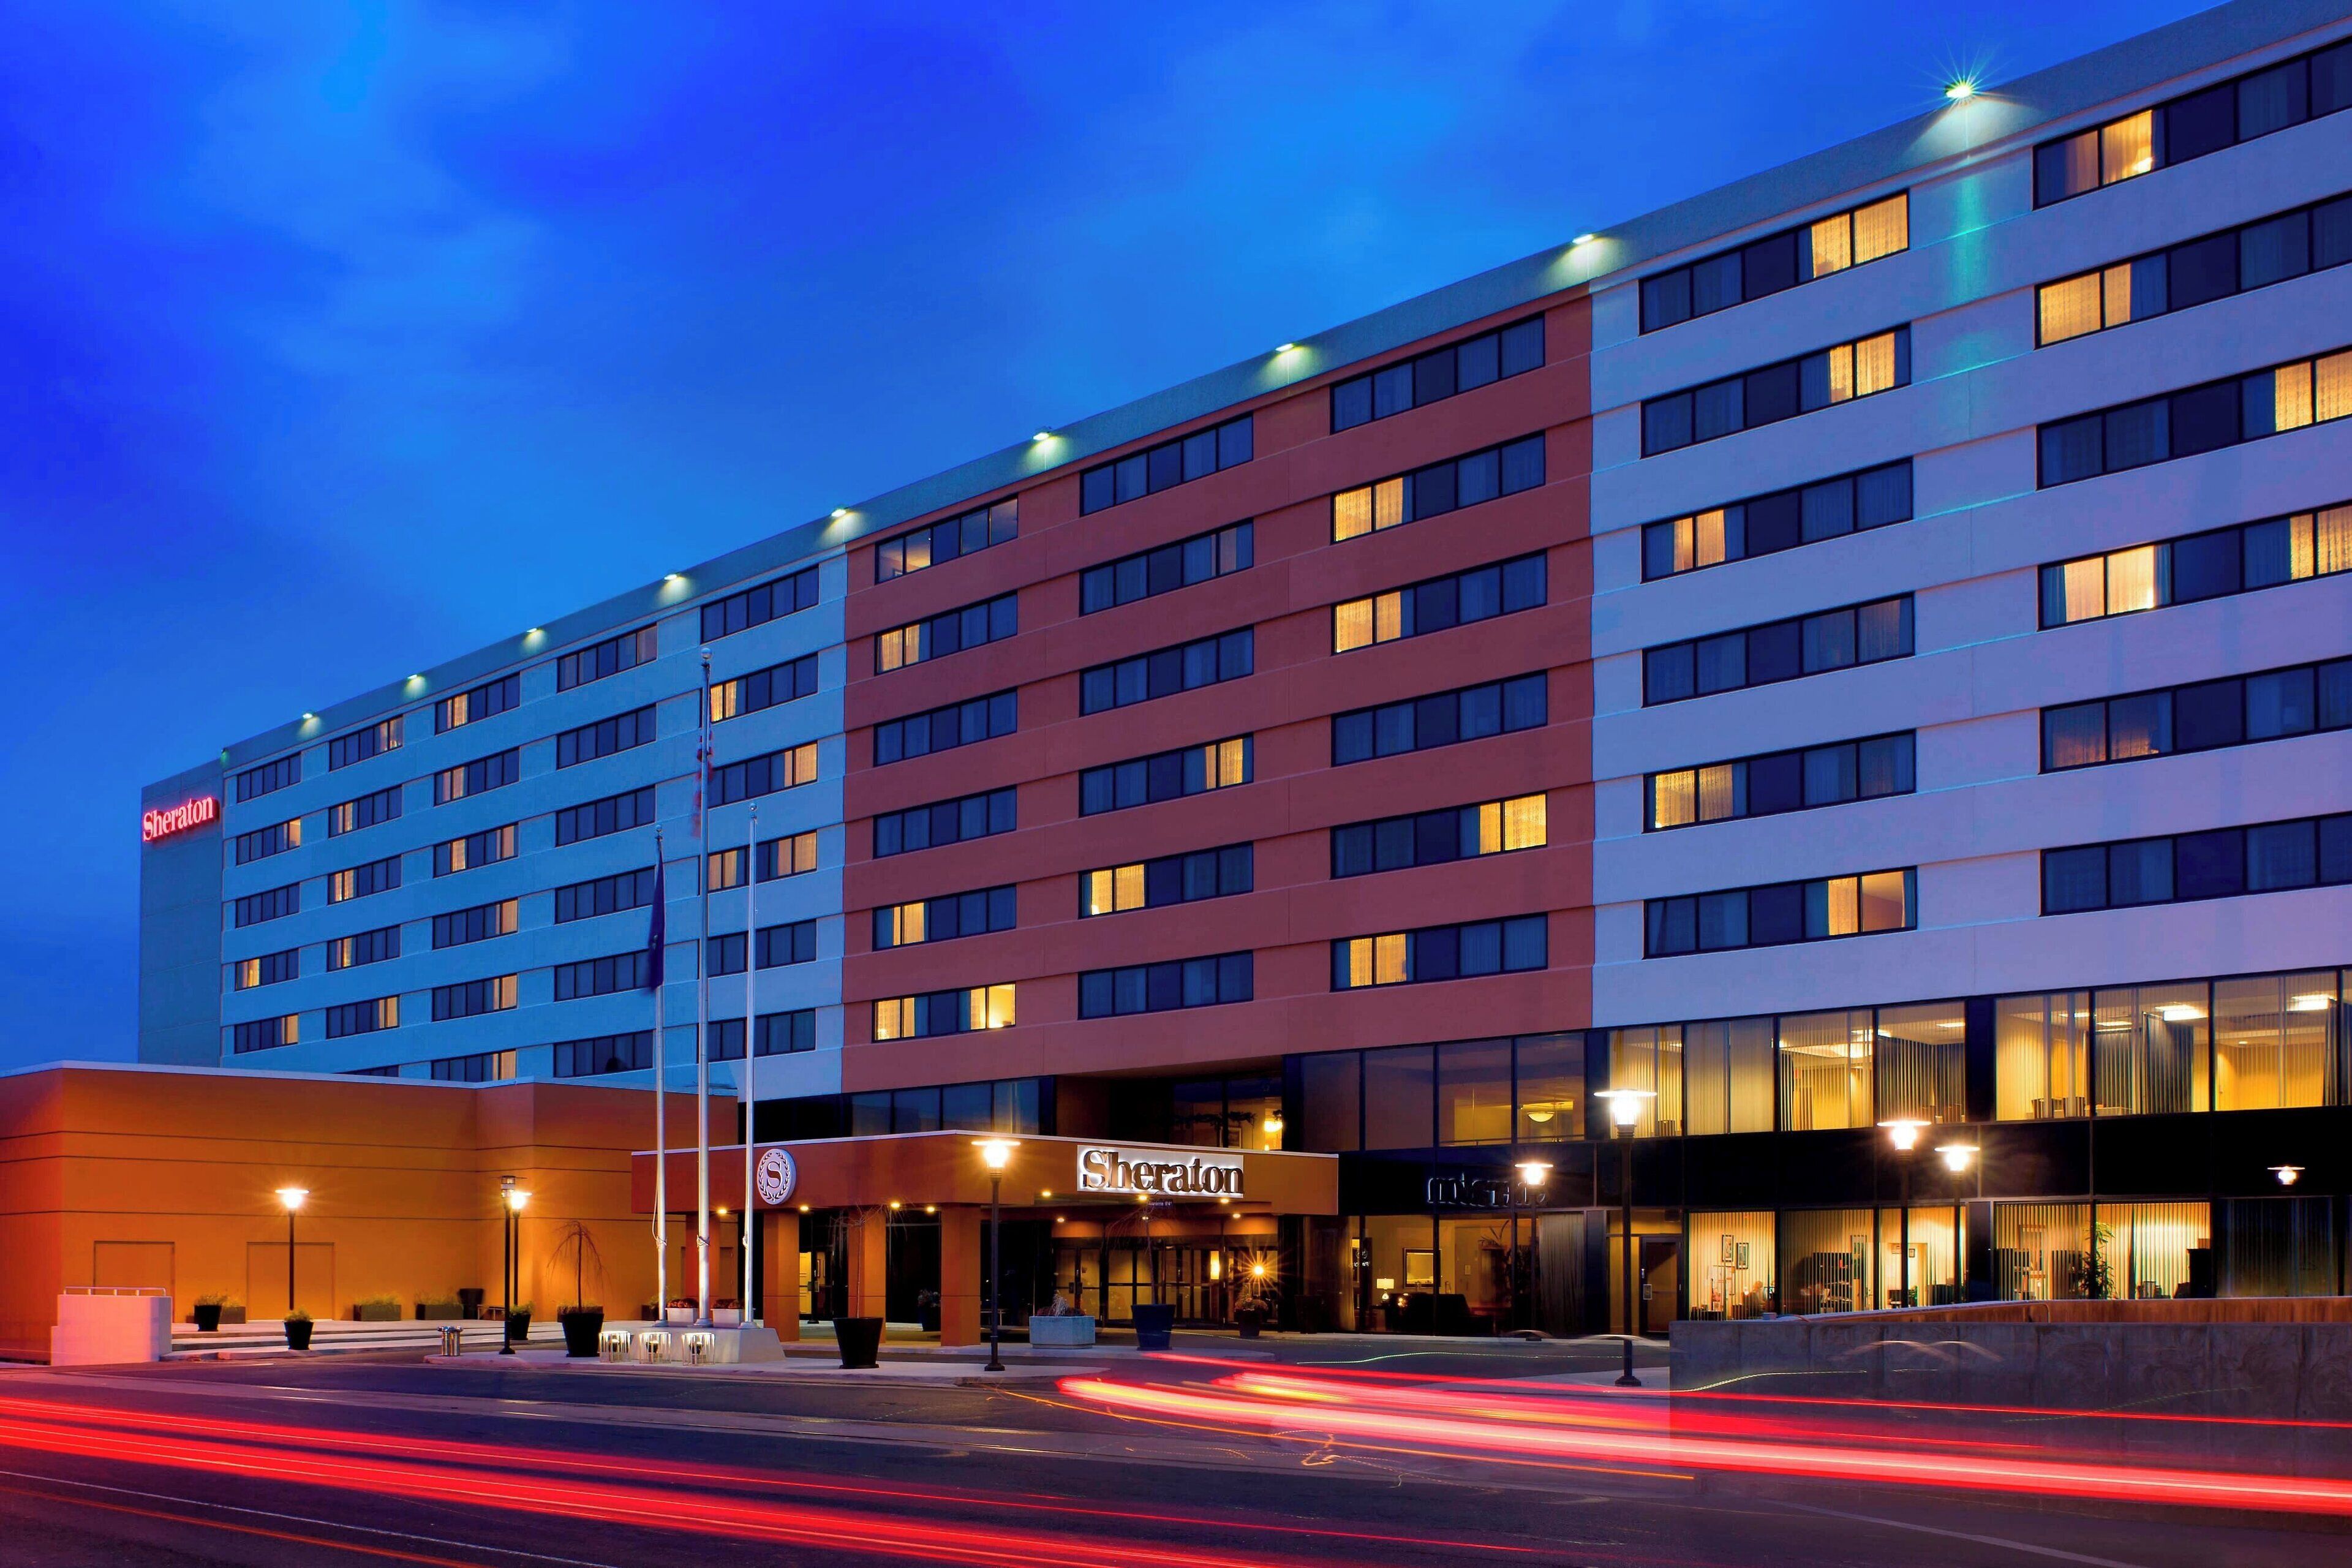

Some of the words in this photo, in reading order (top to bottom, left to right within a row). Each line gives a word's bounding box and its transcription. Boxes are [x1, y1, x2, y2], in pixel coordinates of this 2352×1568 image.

[143, 796, 214, 842] Sheraton
[766, 1161, 782, 1189] S
[1082, 1150, 1244, 1194] Sheraton
